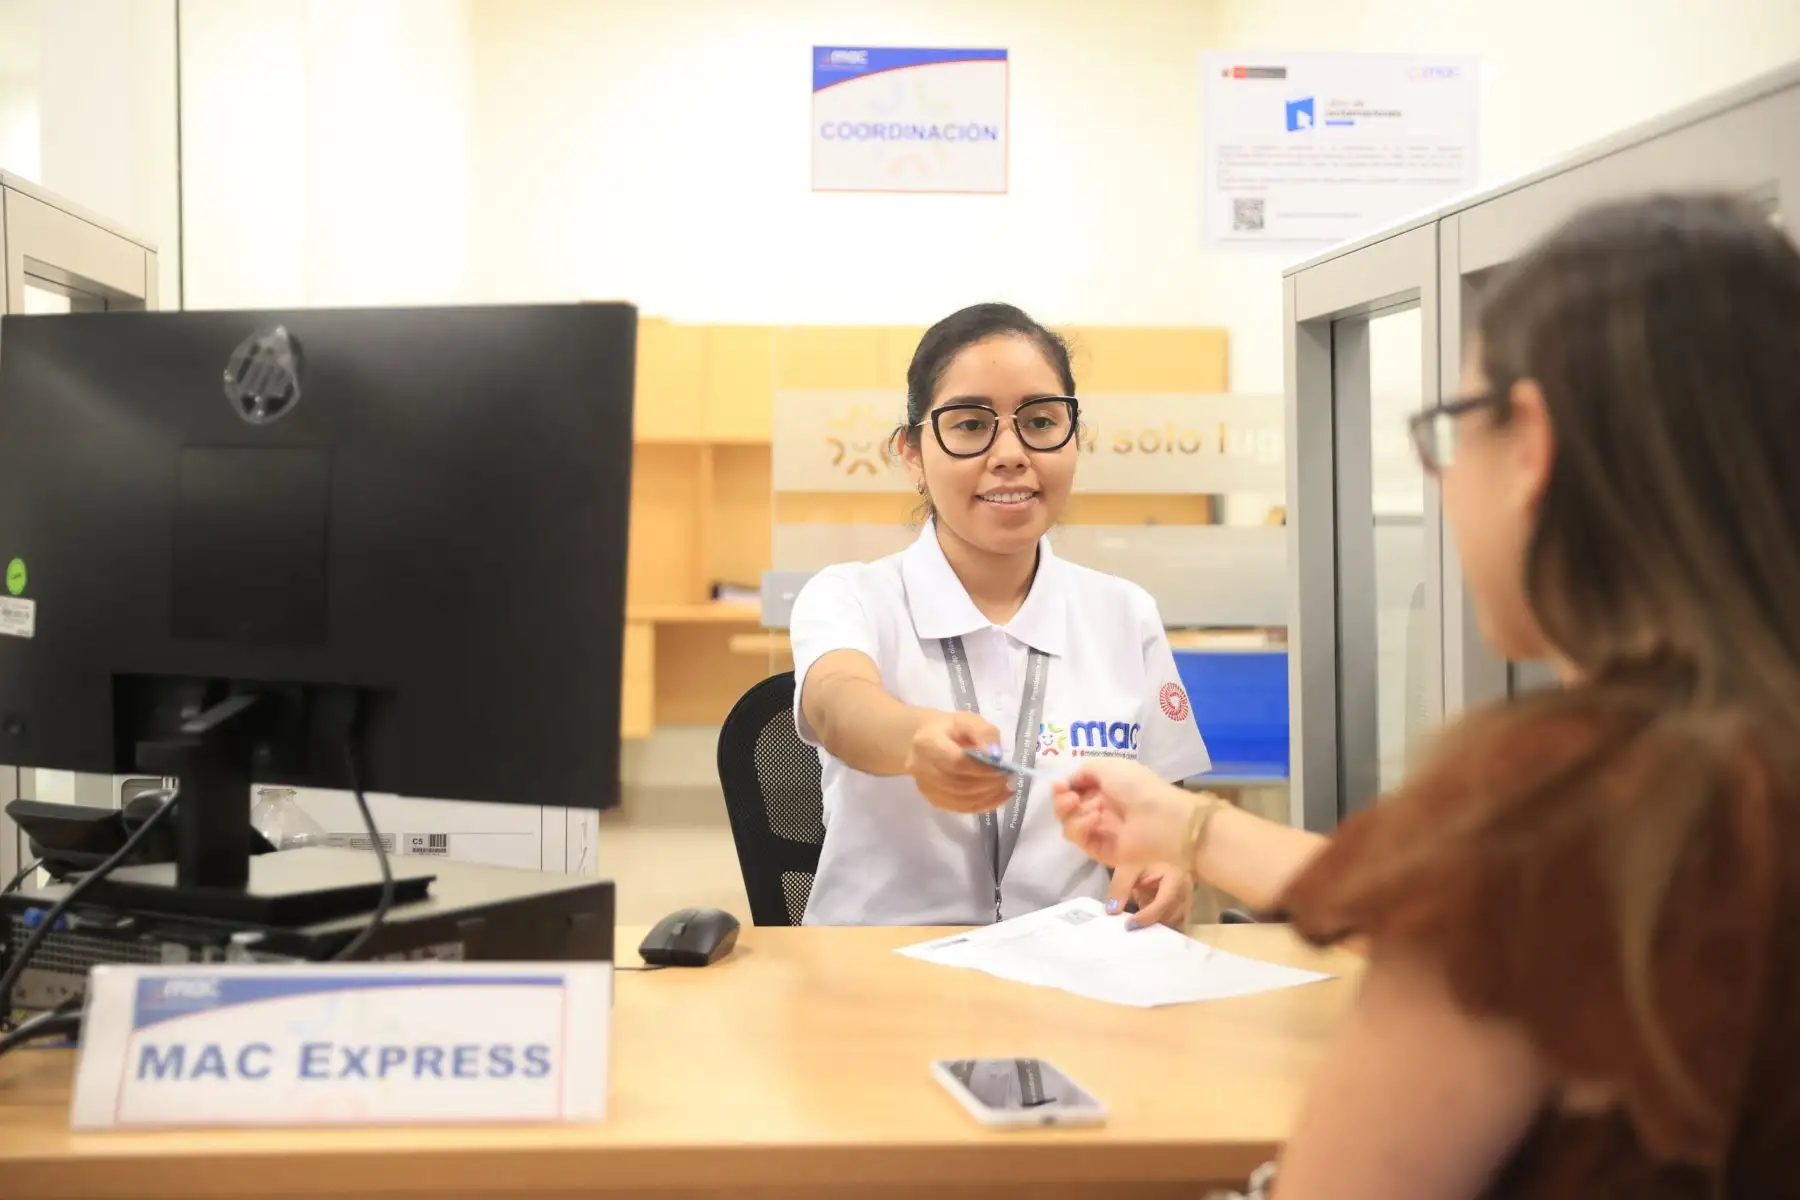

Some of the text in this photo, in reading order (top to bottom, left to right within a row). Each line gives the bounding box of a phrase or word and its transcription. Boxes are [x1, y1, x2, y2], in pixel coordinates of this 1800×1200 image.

[820, 119, 998, 141] COORDINACIÓN
[1112, 421, 1202, 454] solo
[1217, 421, 1284, 462] lug
[137, 1042, 552, 1081] MAC EXPRESS
